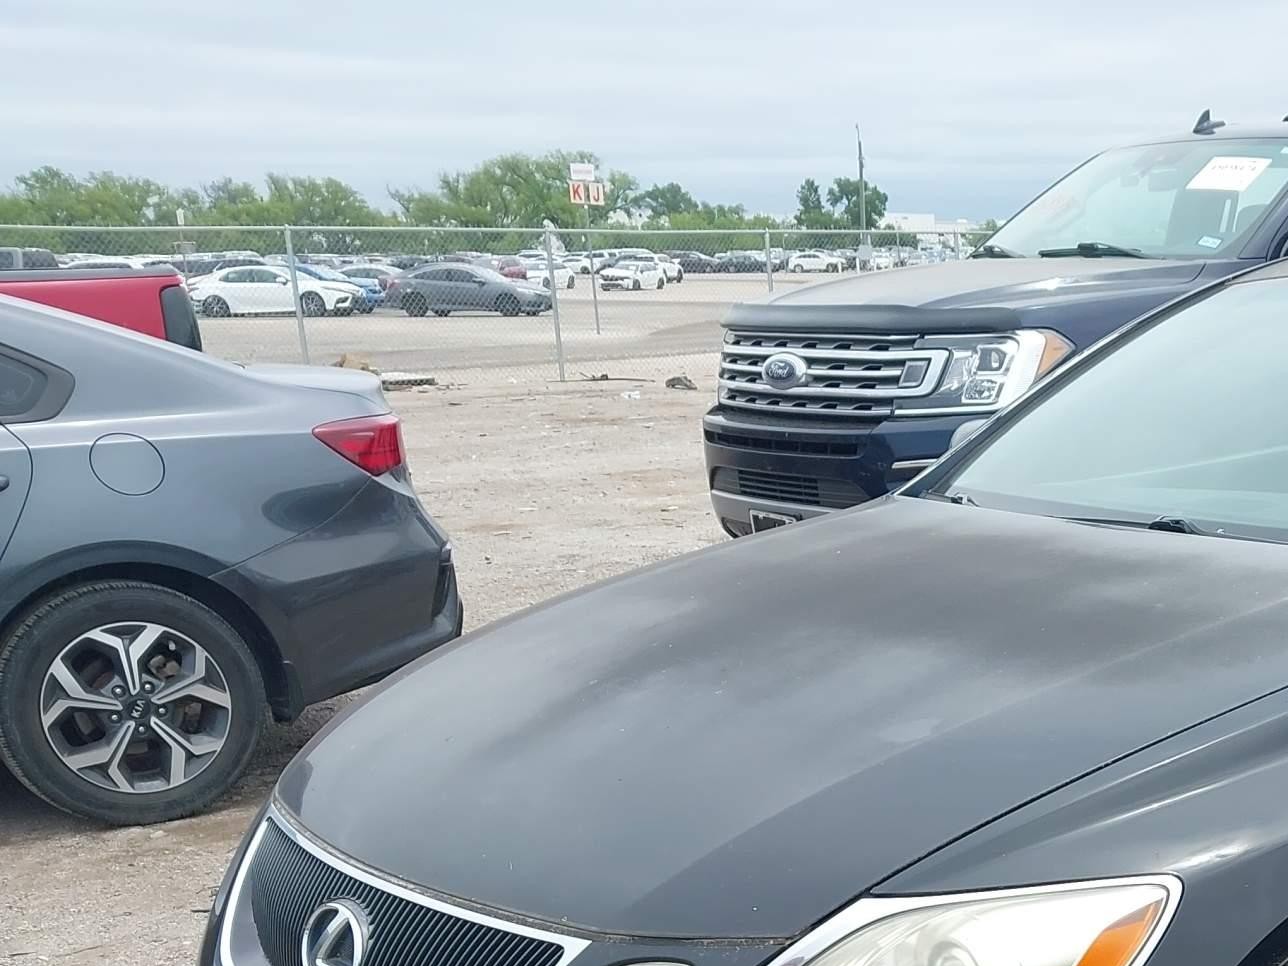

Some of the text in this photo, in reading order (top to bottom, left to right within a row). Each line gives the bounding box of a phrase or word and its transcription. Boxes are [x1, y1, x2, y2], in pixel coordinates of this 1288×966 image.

[571, 183, 583, 201] K
[592, 185, 600, 202] J
[768, 361, 790, 378] Ford
[130, 700, 146, 718] KIA
